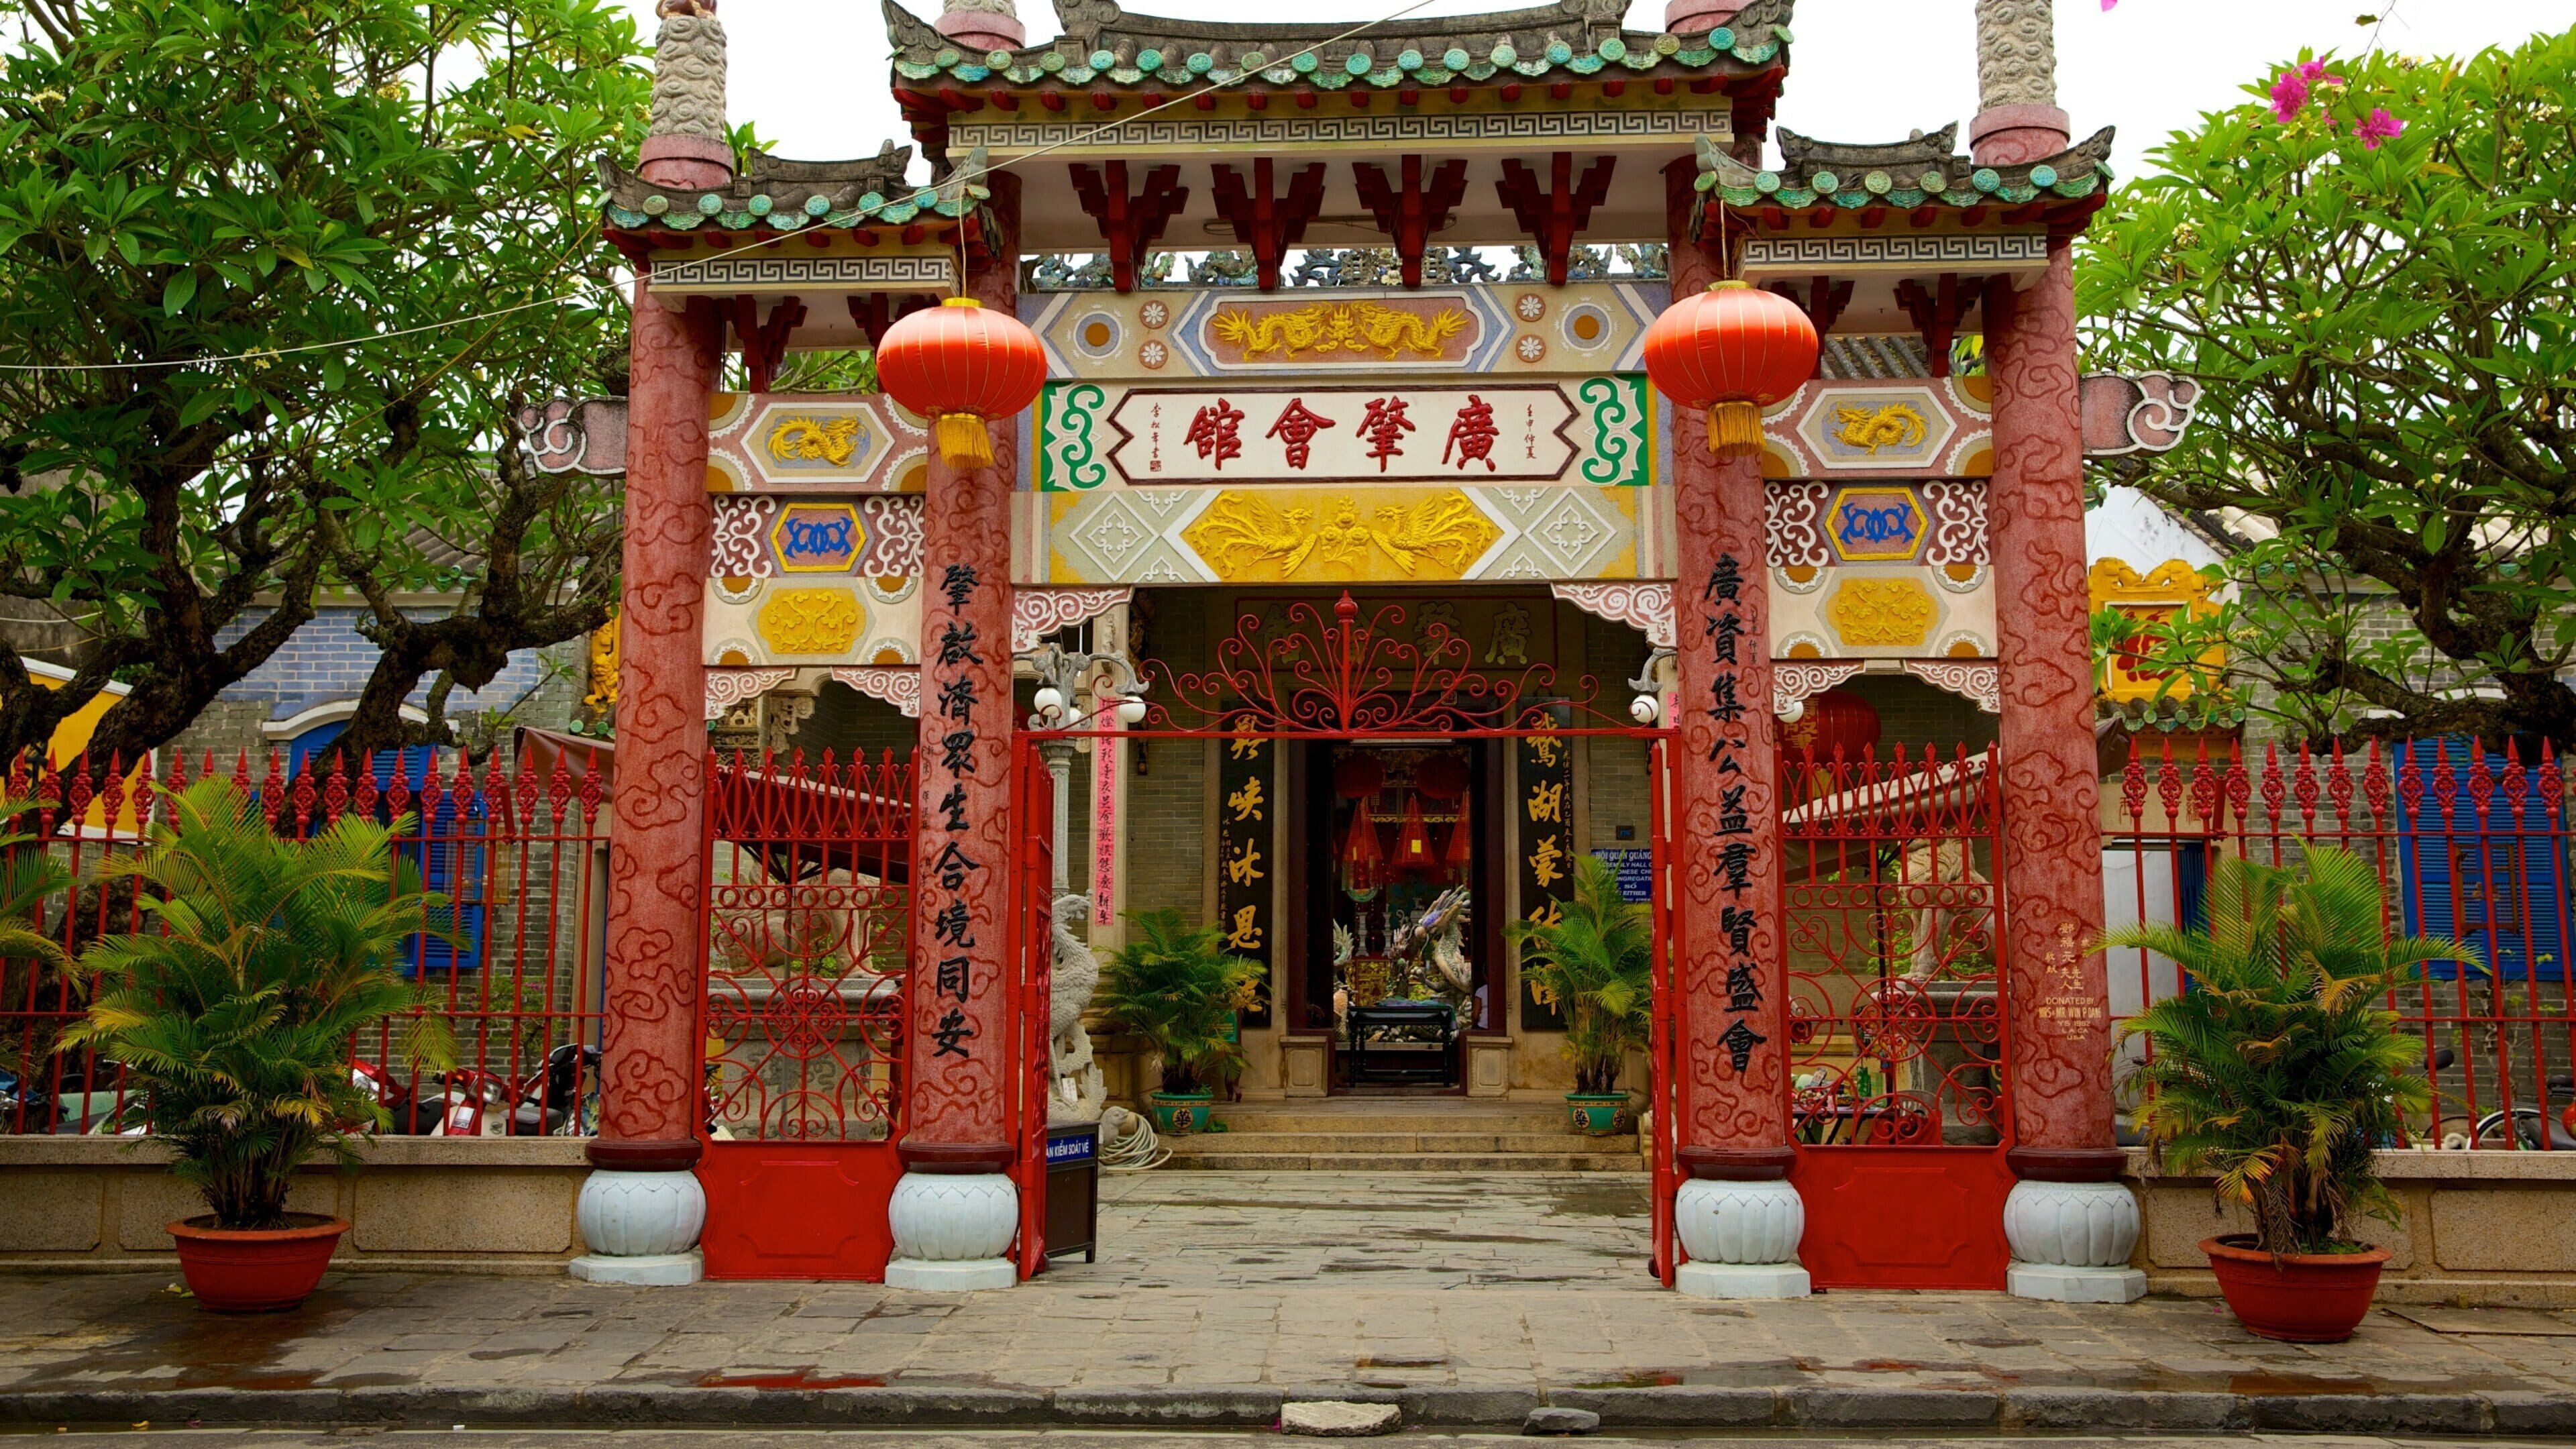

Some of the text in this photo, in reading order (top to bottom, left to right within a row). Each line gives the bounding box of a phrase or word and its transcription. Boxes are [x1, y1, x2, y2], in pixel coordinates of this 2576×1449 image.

[1183, 394, 1502, 473] 廣肇會館
[2045, 997, 2094, 1005] DONATED BY
[2068, 1007, 2081, 1018] WIN
[2082, 1007, 2087, 1018] P
